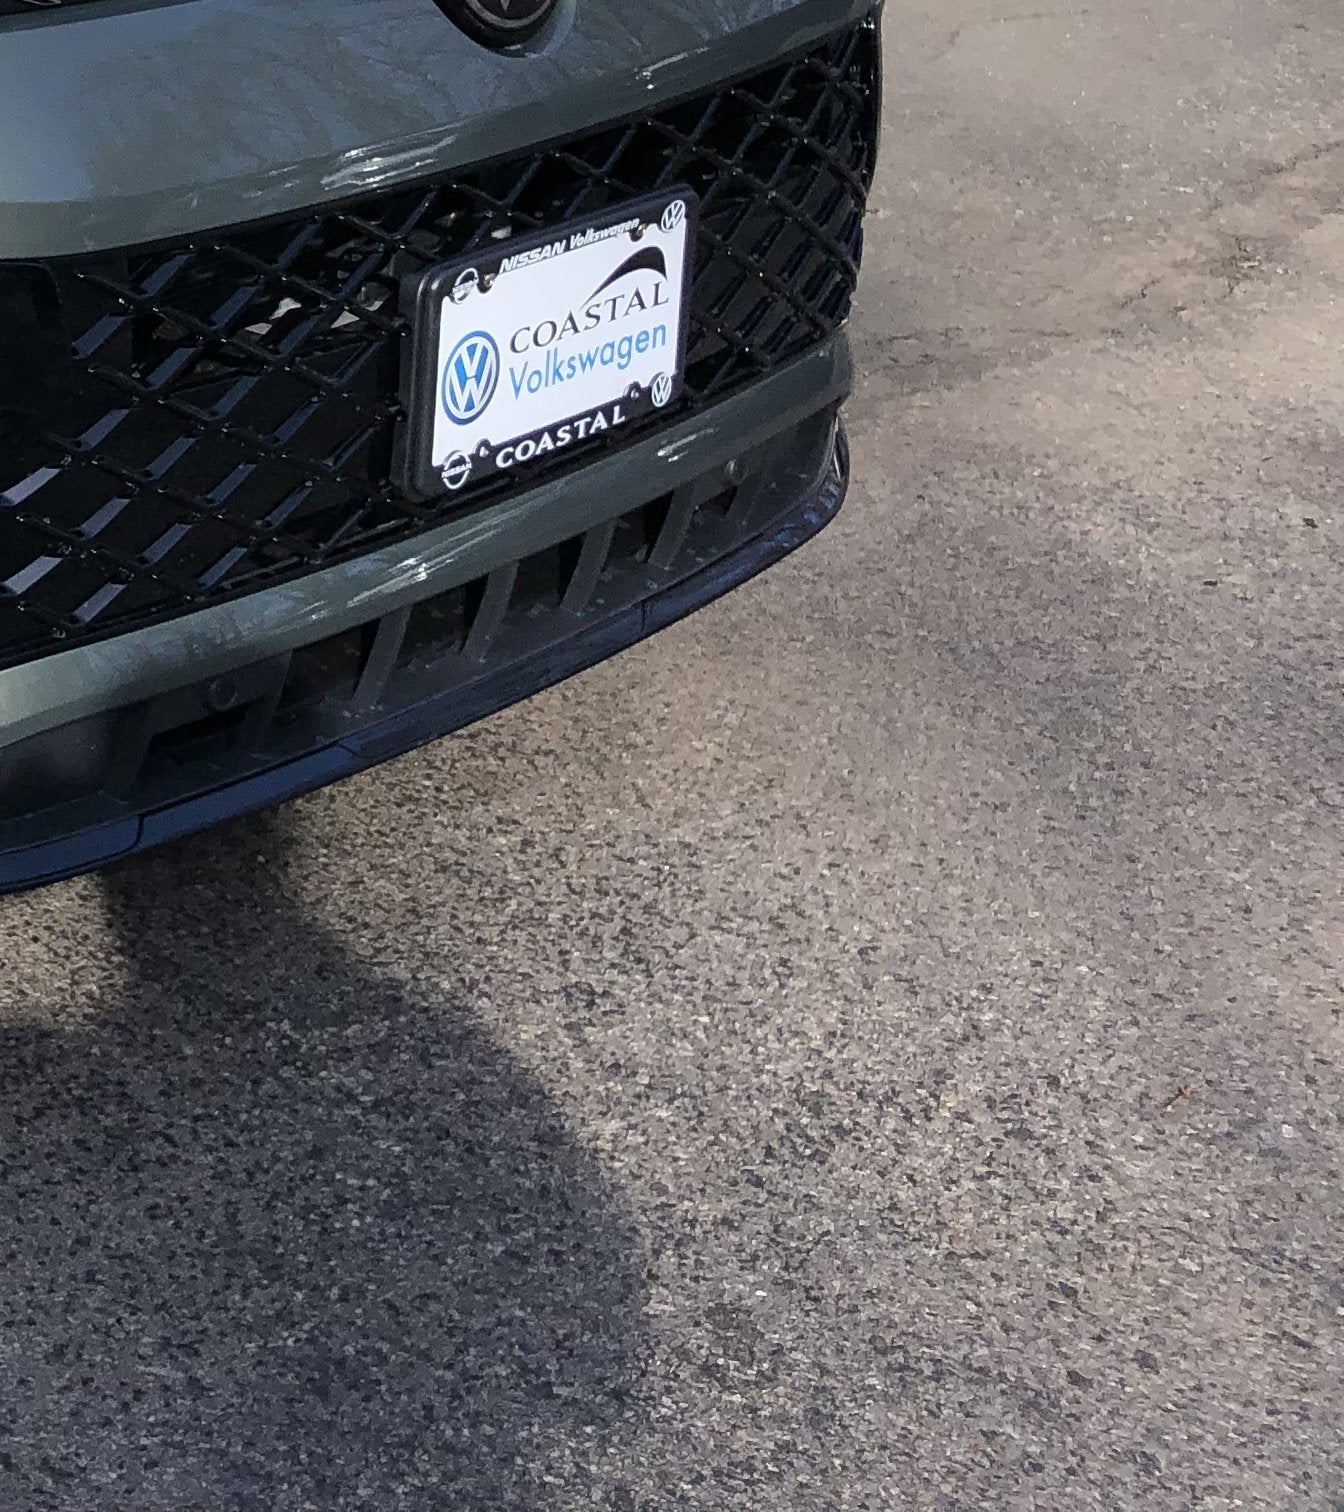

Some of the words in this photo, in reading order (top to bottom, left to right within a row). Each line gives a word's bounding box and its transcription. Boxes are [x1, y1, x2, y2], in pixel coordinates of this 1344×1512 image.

[499, 239, 566, 274] NISSAN
[569, 218, 640, 250] Volkswagen
[509, 281, 670, 355] COASTAL
[509, 323, 667, 401] Volkswagen
[495, 405, 626, 469] COASTAL
